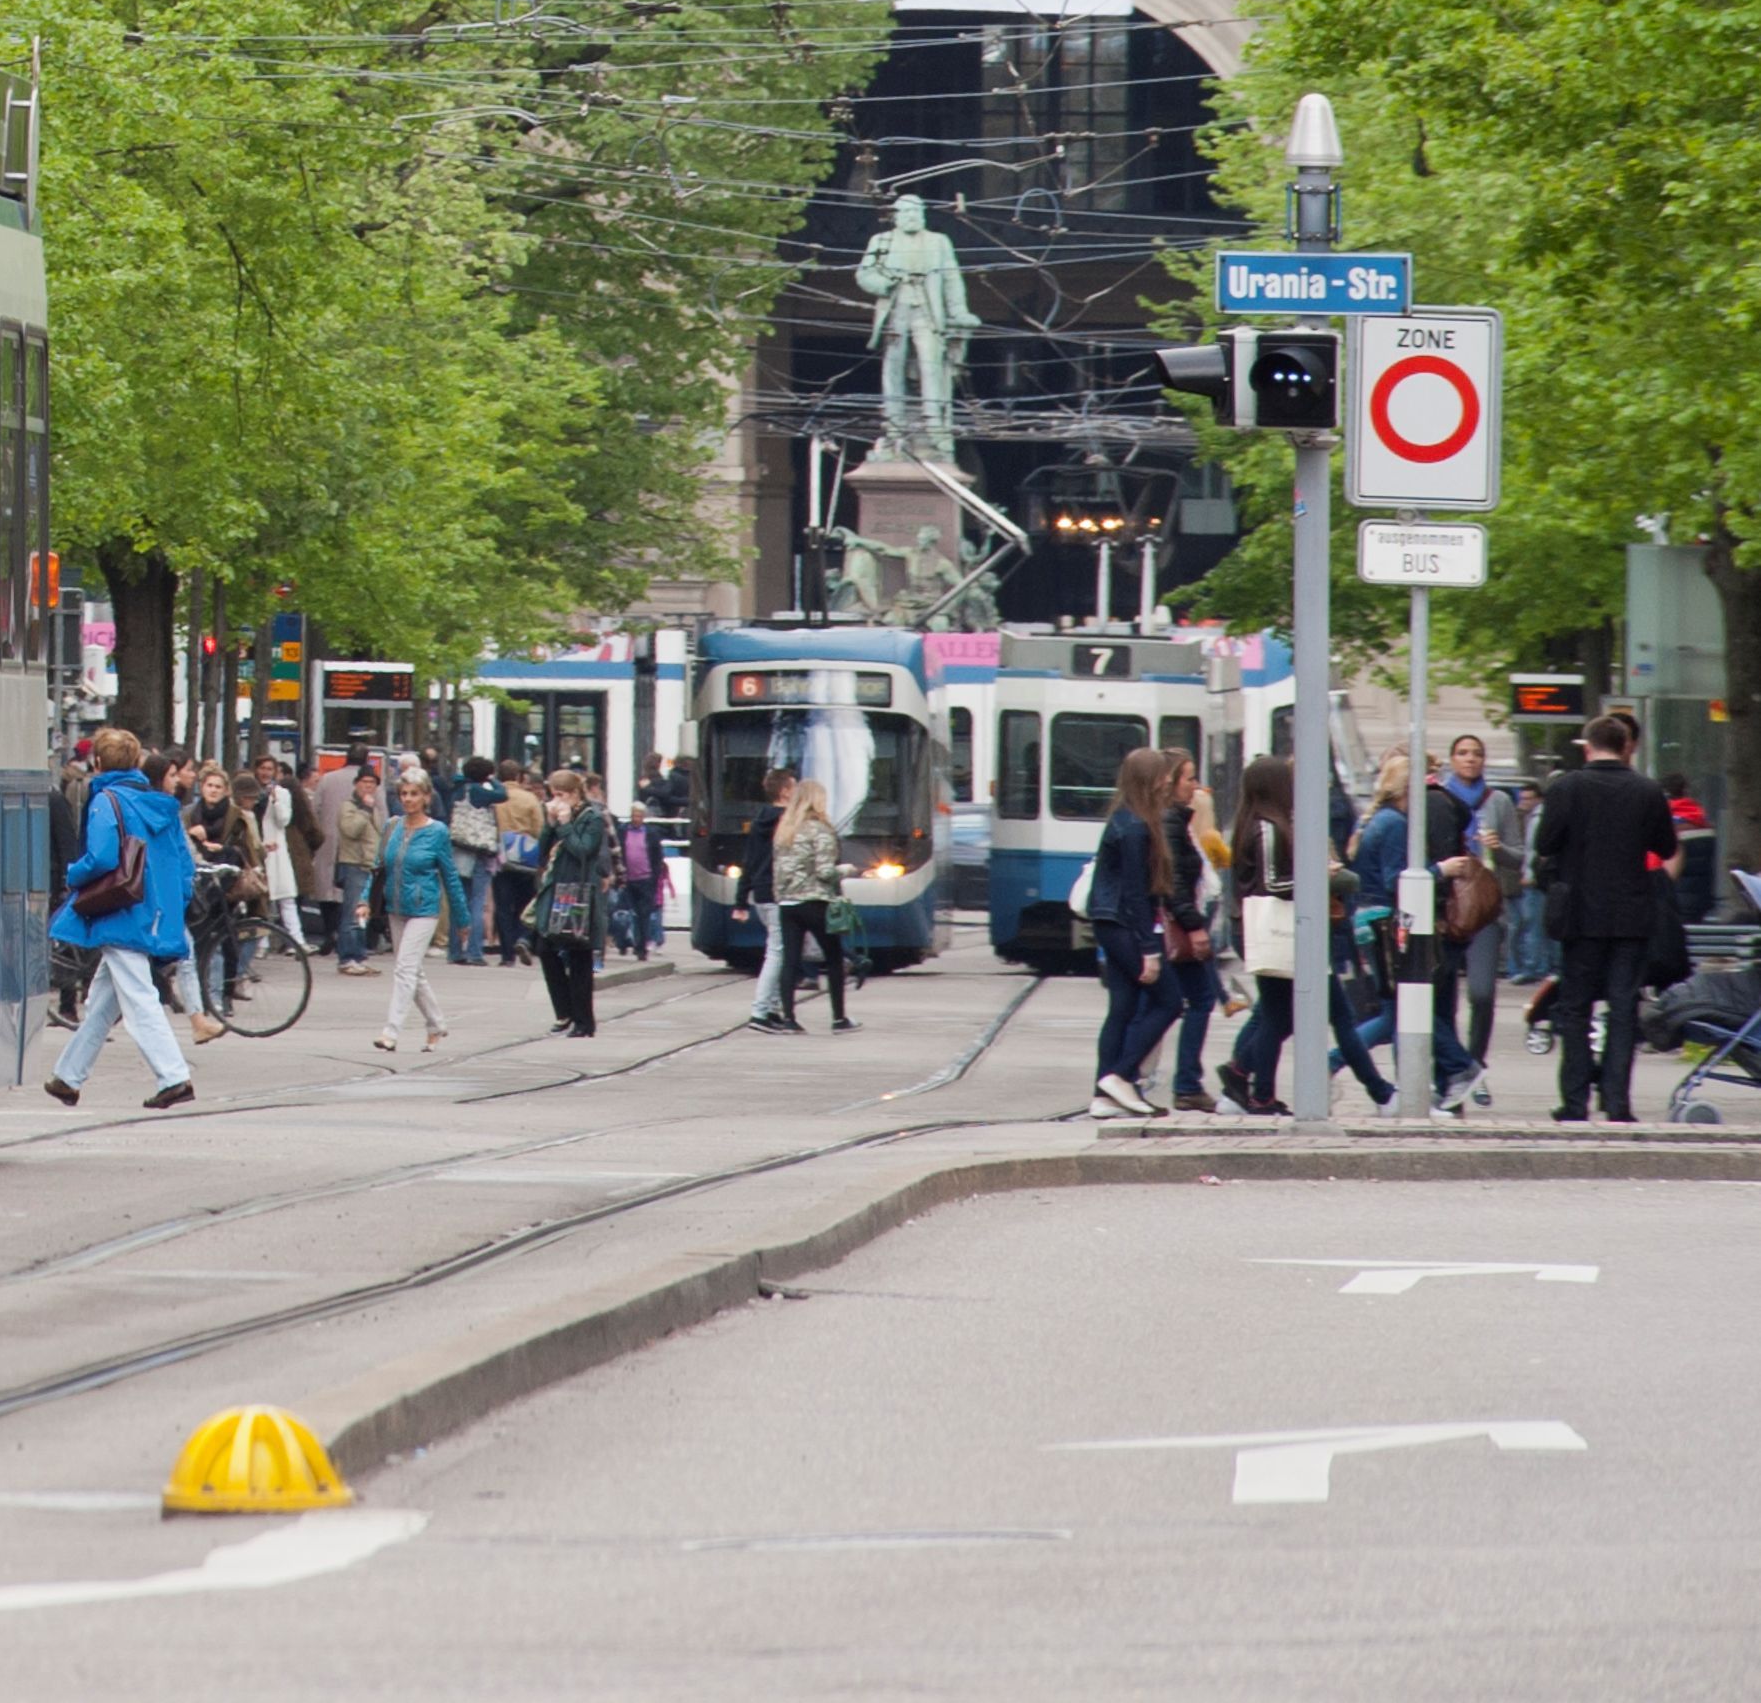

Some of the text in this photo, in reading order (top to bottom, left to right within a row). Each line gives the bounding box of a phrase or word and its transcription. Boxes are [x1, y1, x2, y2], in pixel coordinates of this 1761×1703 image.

[1397, 328, 1456, 349] ZONE
[1377, 531, 1464, 547] ausgenommen
[1402, 553, 1440, 574] BUS
[1090, 647, 1114, 675] 7
[740, 676, 758, 697] 6
